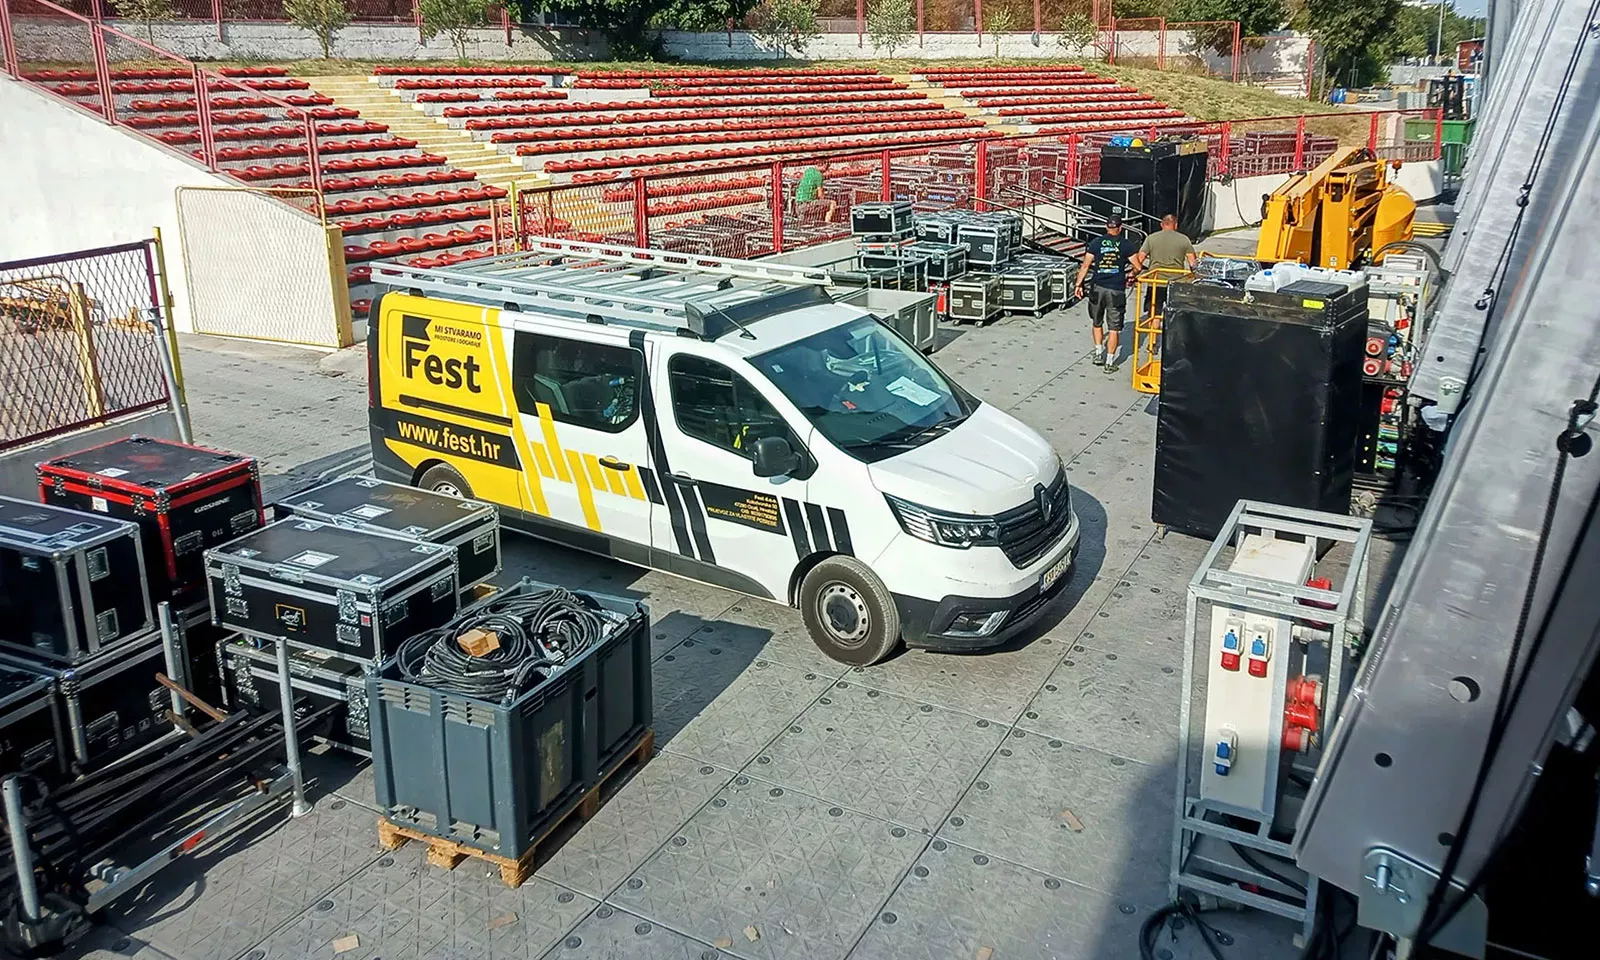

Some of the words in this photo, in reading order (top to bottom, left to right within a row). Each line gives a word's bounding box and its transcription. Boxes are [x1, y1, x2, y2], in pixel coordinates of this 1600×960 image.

[434, 325, 444, 334] MI
[444, 326, 482, 340] STVARAMO
[402, 340, 481, 393] Fest
[397, 421, 500, 460] www.fest.hr
